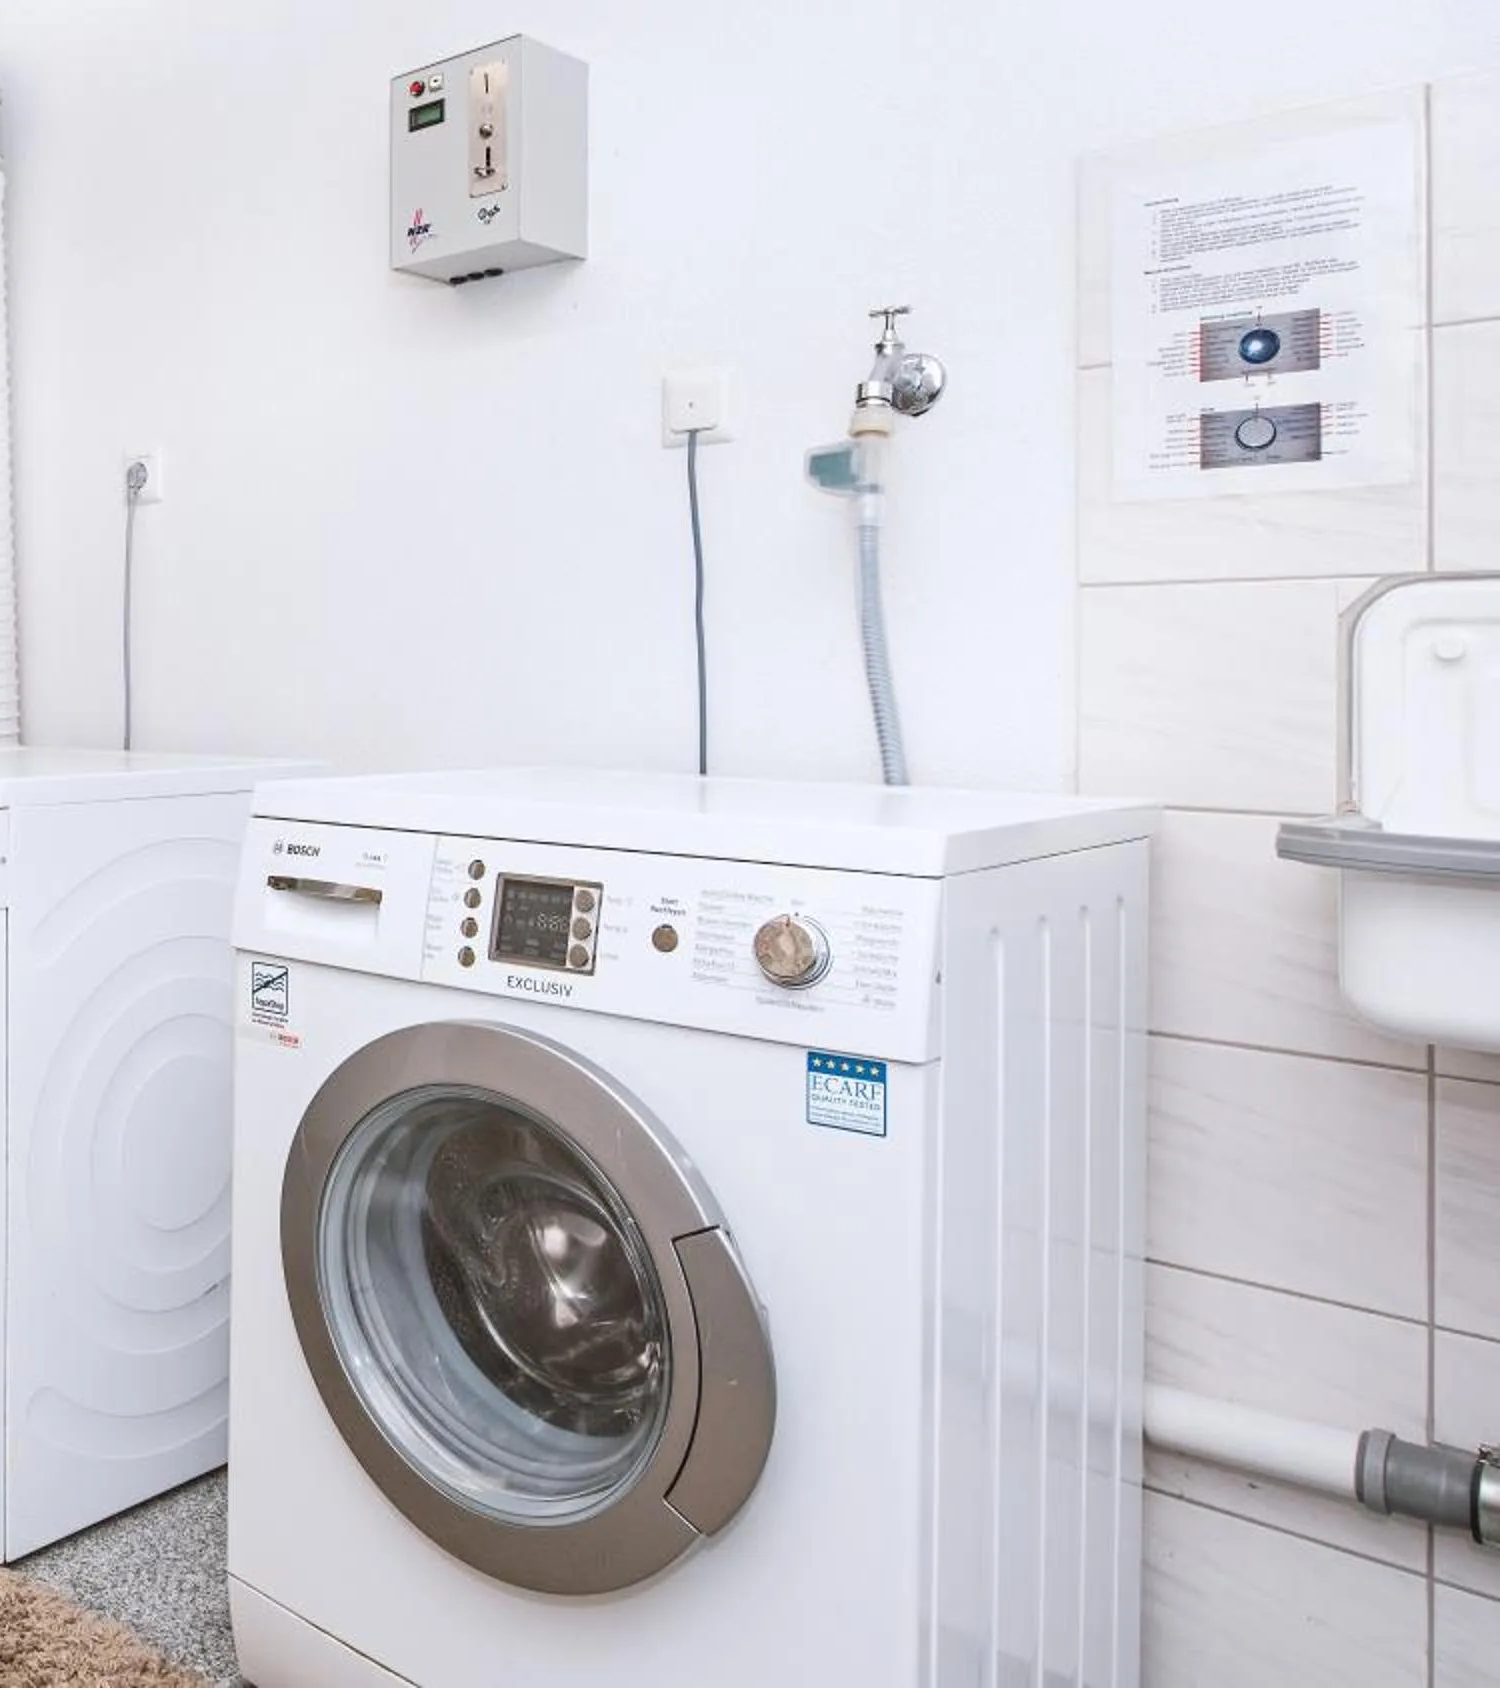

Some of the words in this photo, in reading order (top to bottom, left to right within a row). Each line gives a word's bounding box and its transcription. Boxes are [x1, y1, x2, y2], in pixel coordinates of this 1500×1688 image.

[286, 843, 321, 857] BOSCH
[507, 975, 573, 997] EXCLUSIV
[813, 1075, 881, 1101] ECARF
